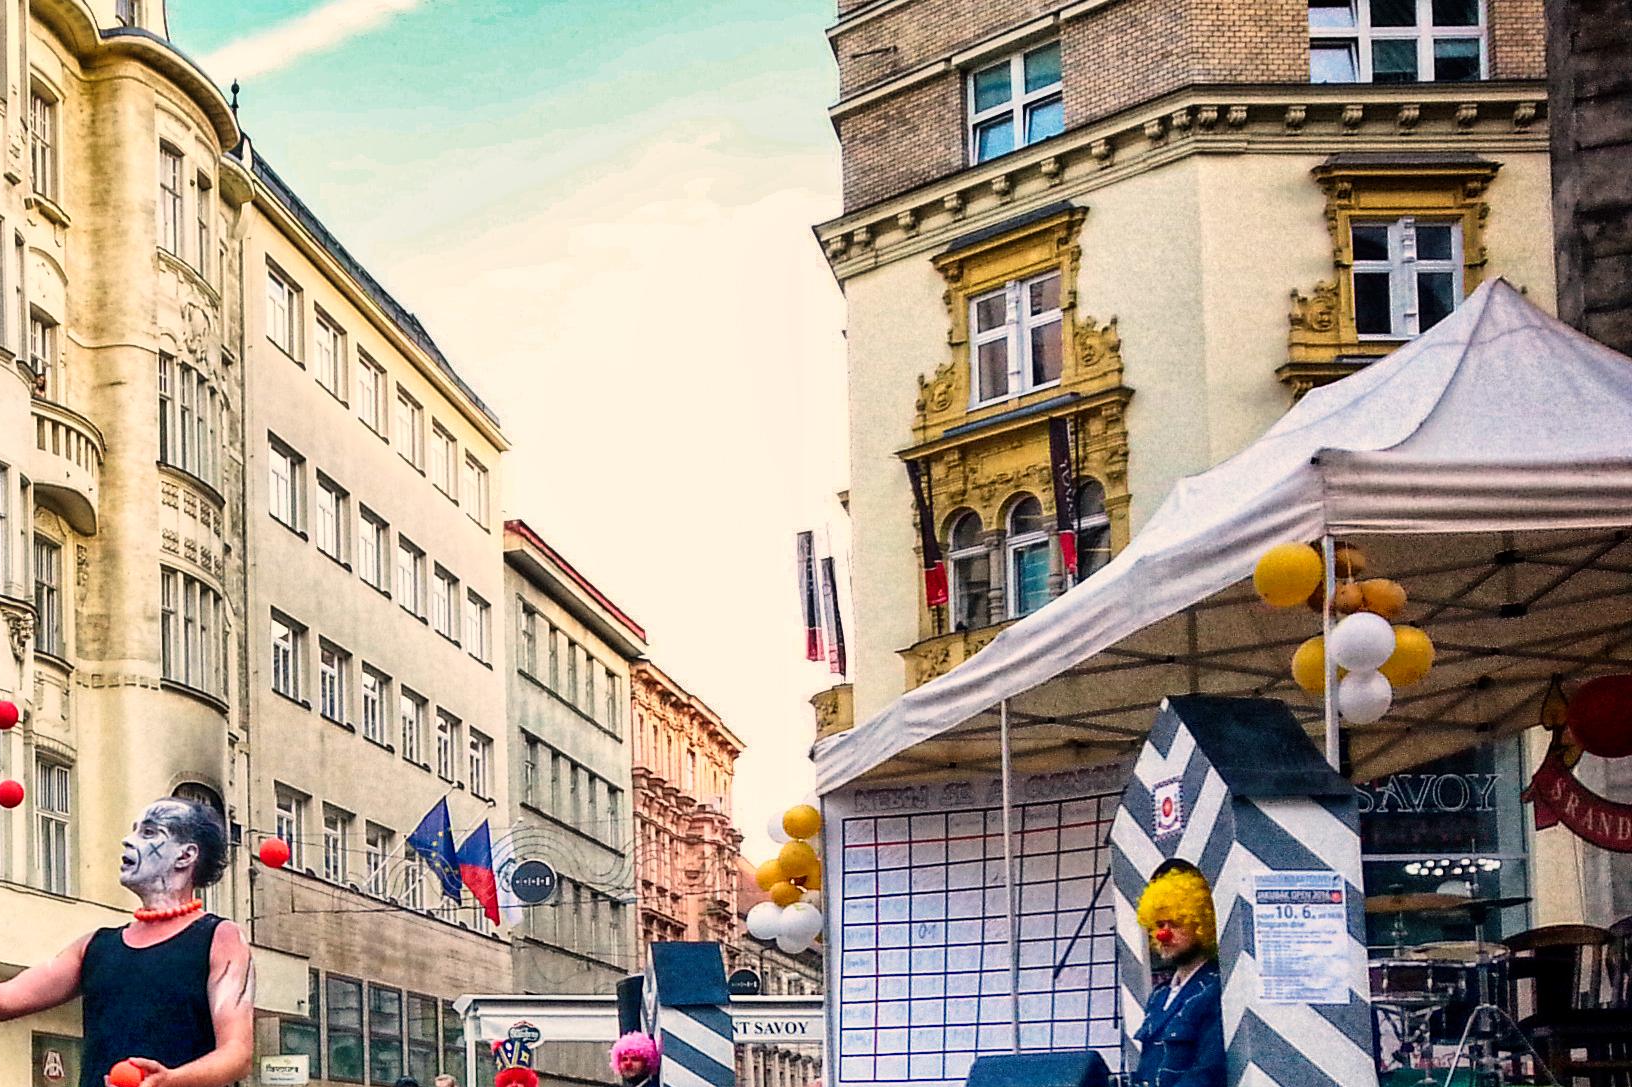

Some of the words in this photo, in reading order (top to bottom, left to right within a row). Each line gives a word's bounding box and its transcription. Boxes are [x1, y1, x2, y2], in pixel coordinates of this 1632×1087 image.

[1354, 773, 1502, 813] SAVOY
[1276, 905, 1298, 919] 10.
[1302, 905, 1316, 919] 6.
[754, 1021, 808, 1035] SAVOY
